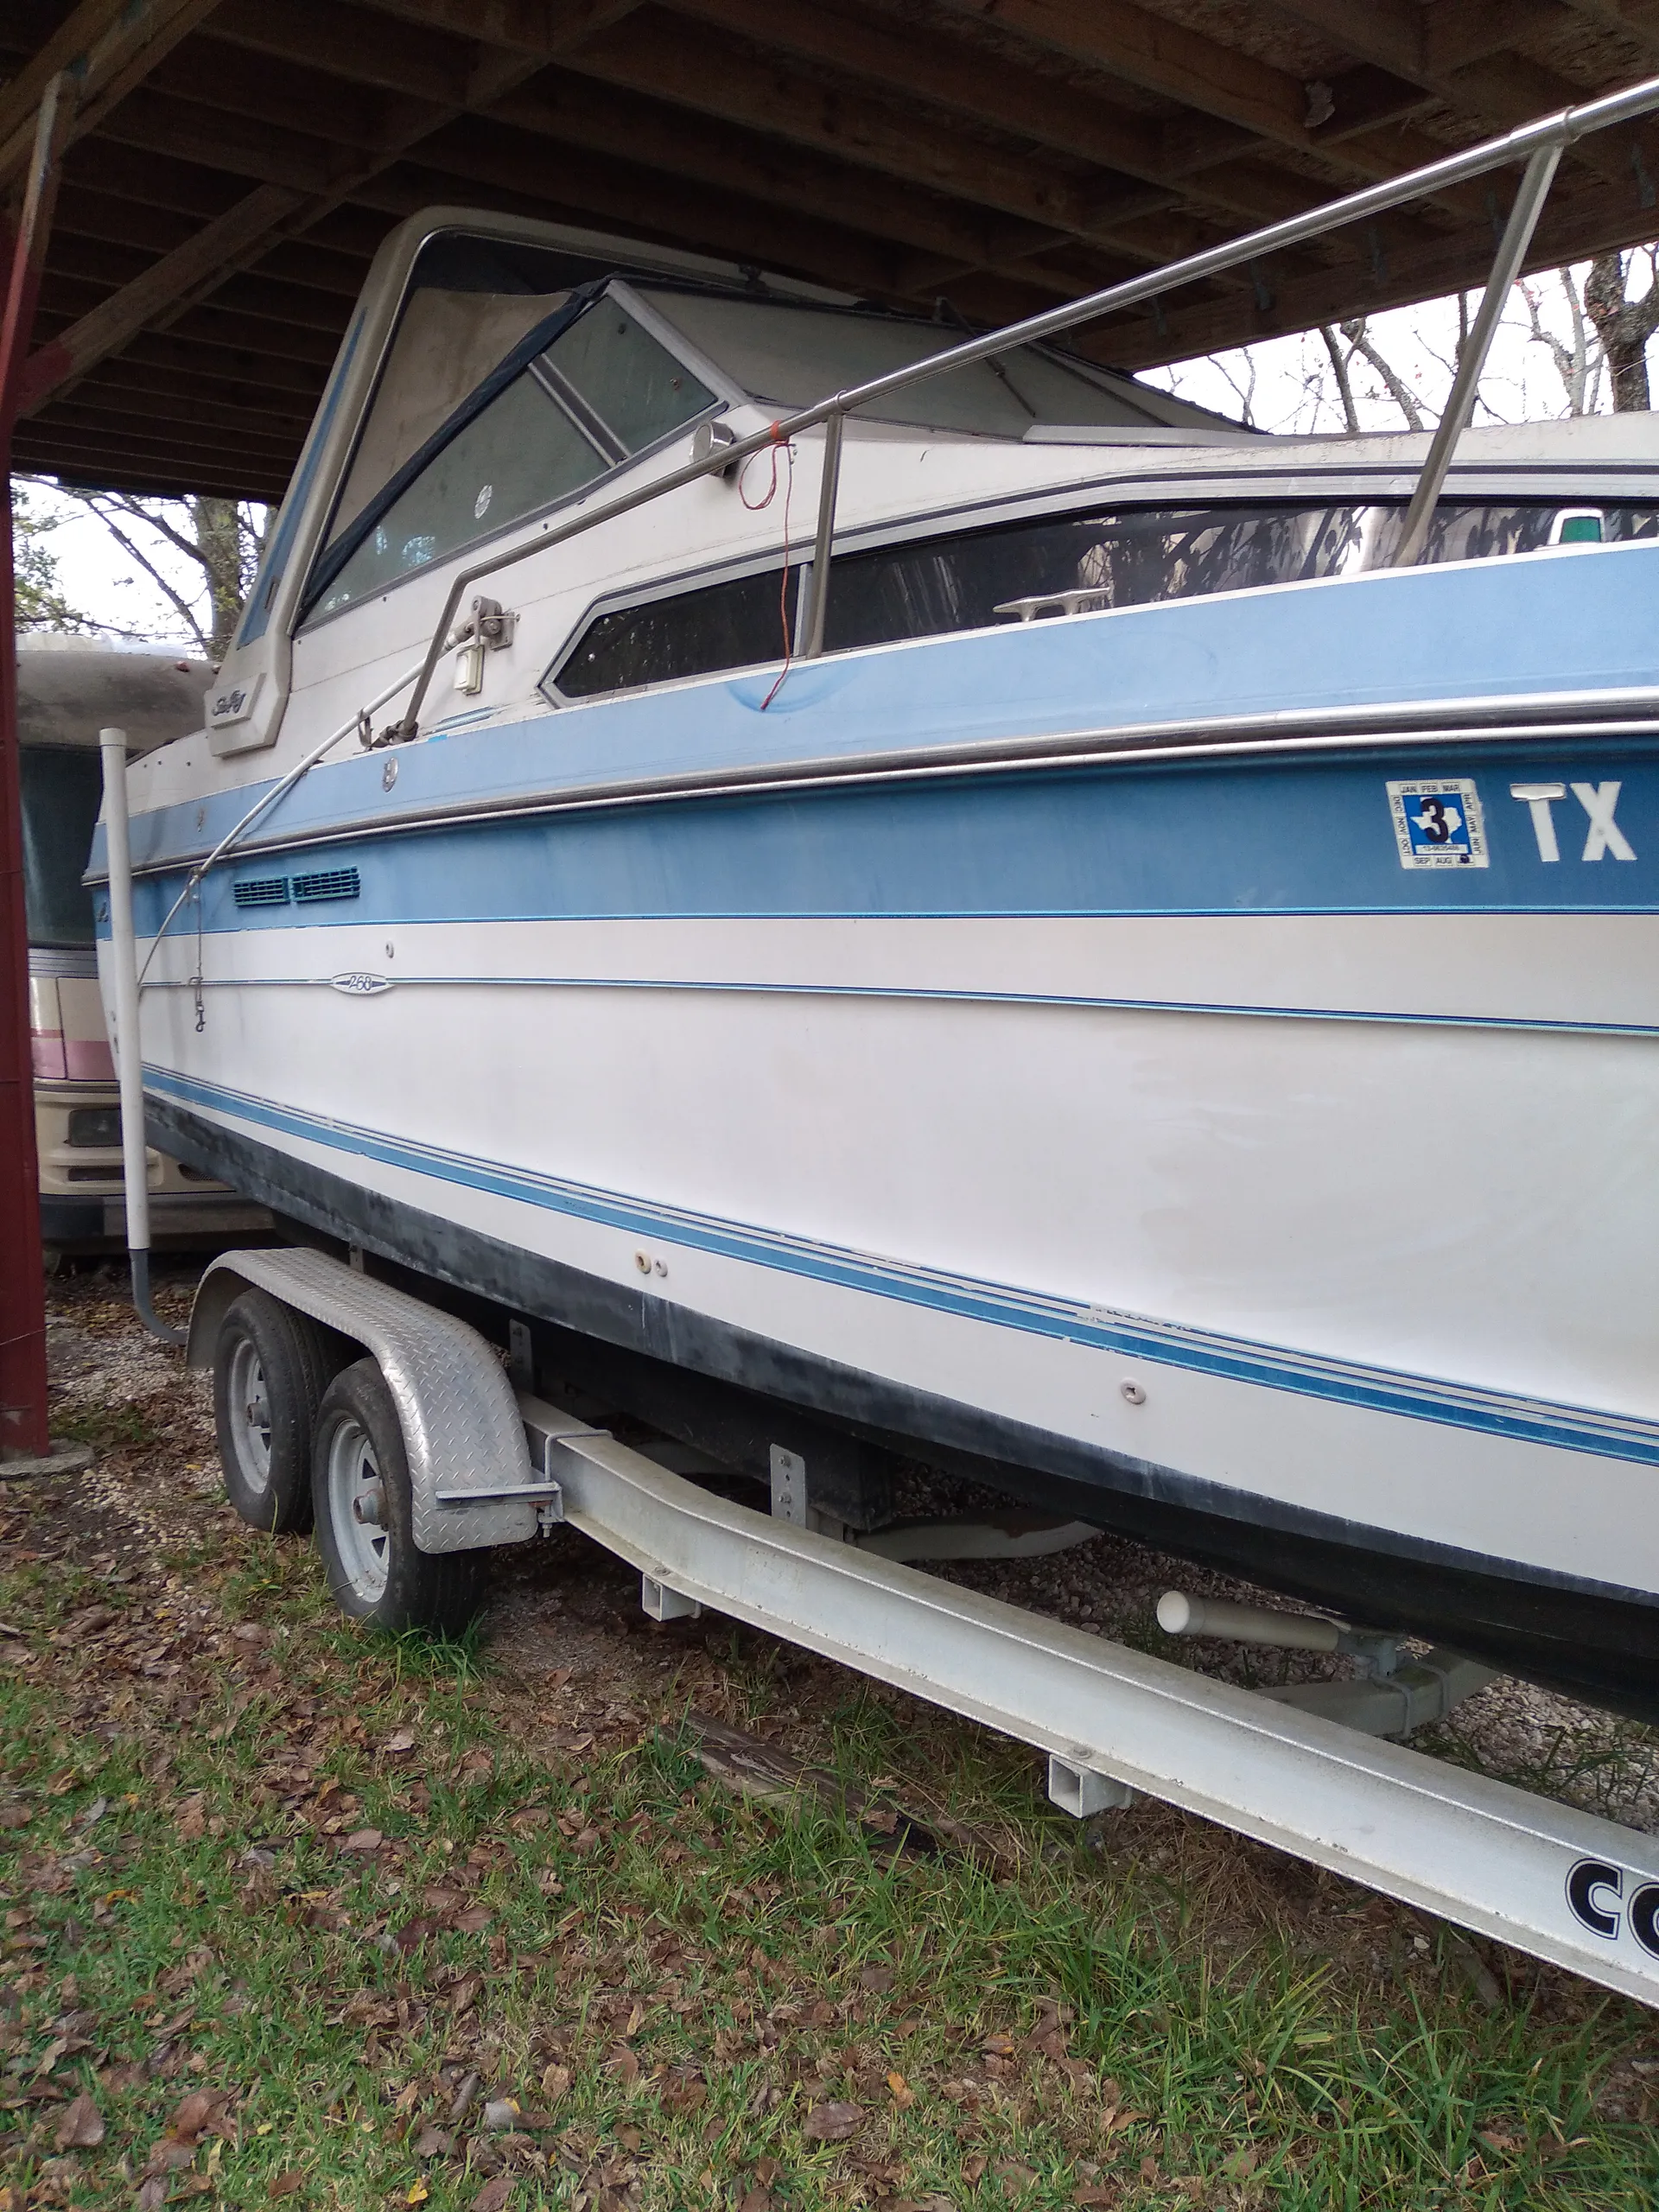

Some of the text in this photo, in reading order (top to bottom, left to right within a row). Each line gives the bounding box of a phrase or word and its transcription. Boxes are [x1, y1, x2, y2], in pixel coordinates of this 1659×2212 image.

[1394, 796, 1411, 856] DEC NOV OCT
[1421, 798, 1448, 842] 3
[1463, 794, 1482, 854] APR MAY JUN
[1510, 781, 1638, 862] TX
